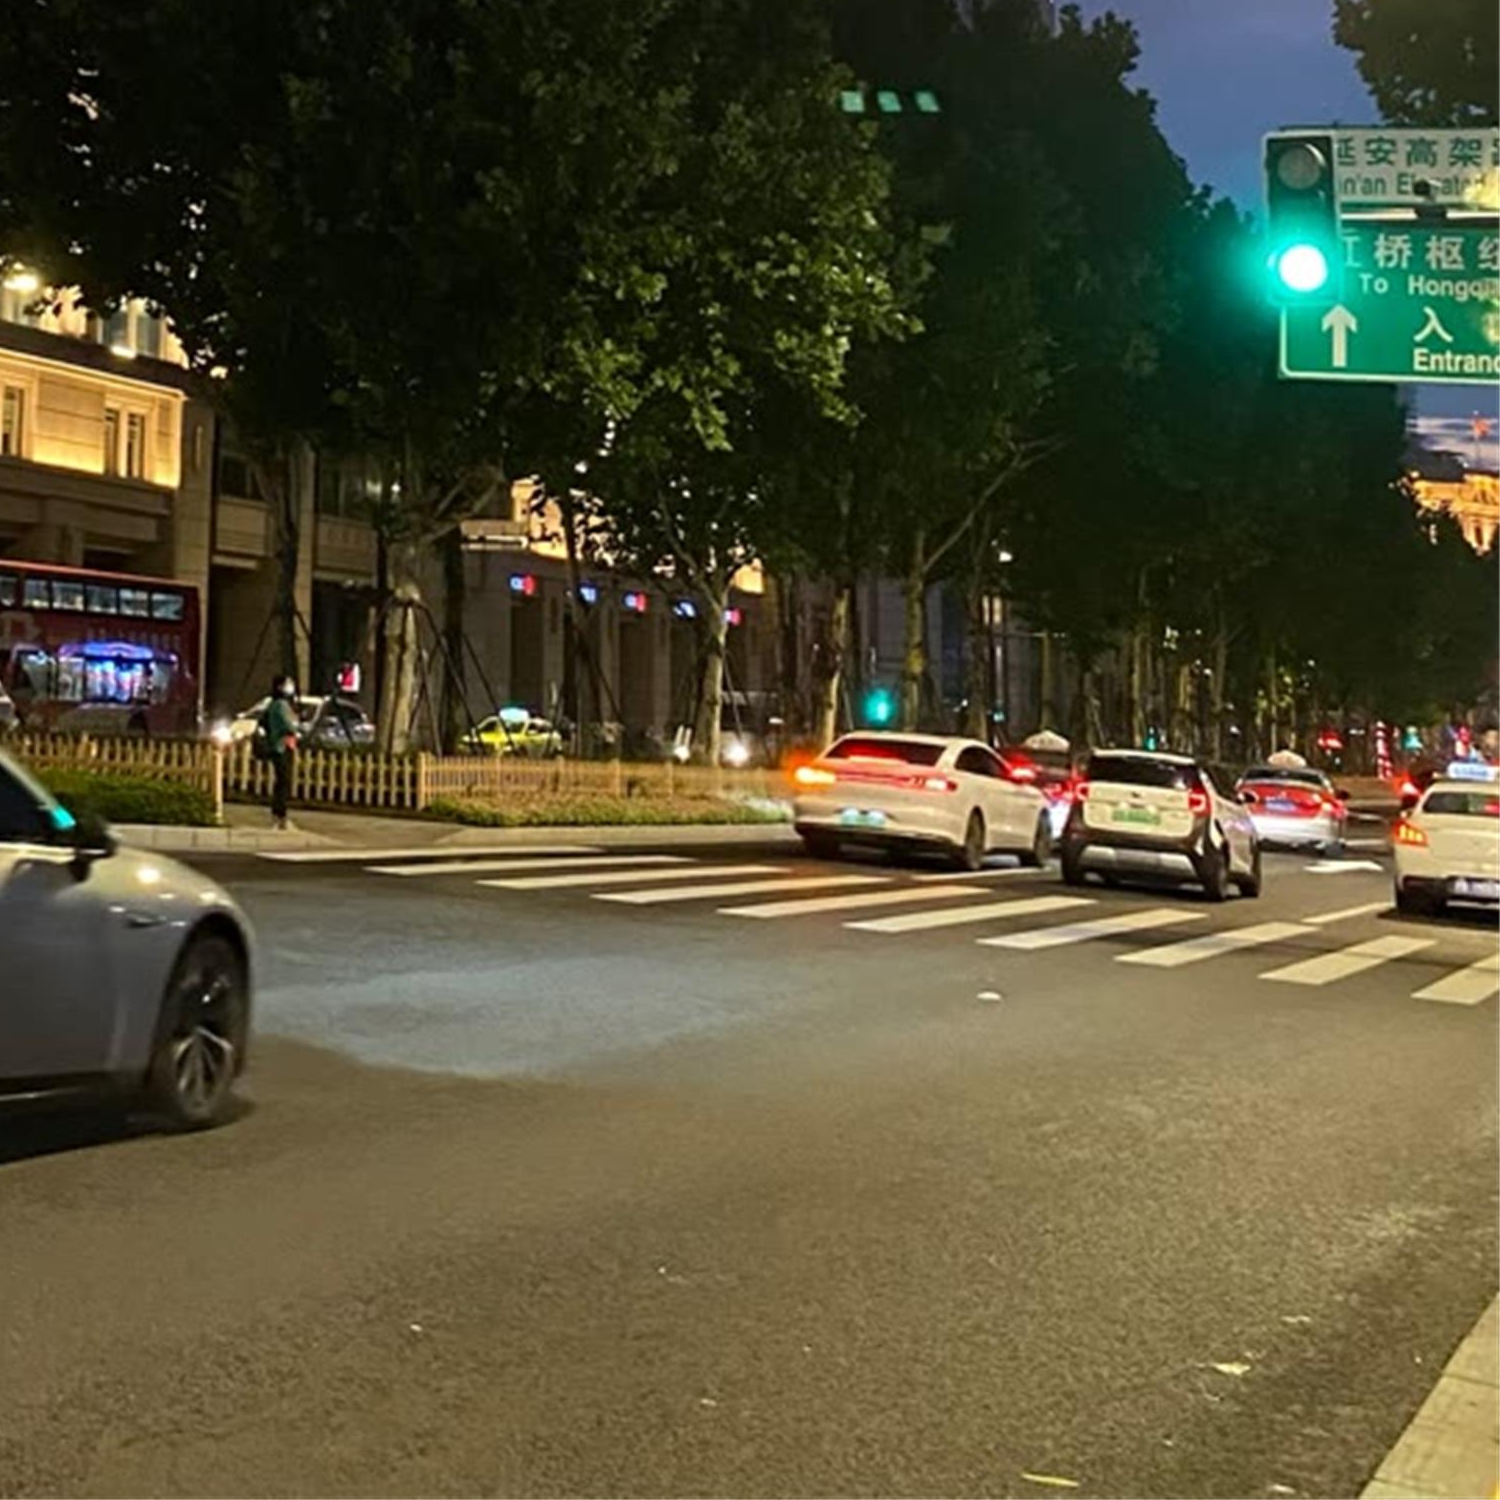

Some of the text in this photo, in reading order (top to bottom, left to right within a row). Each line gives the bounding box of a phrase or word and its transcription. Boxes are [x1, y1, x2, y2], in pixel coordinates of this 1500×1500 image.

[1337, 136, 1500, 167] 延安高架
[1359, 273, 1389, 294] To
